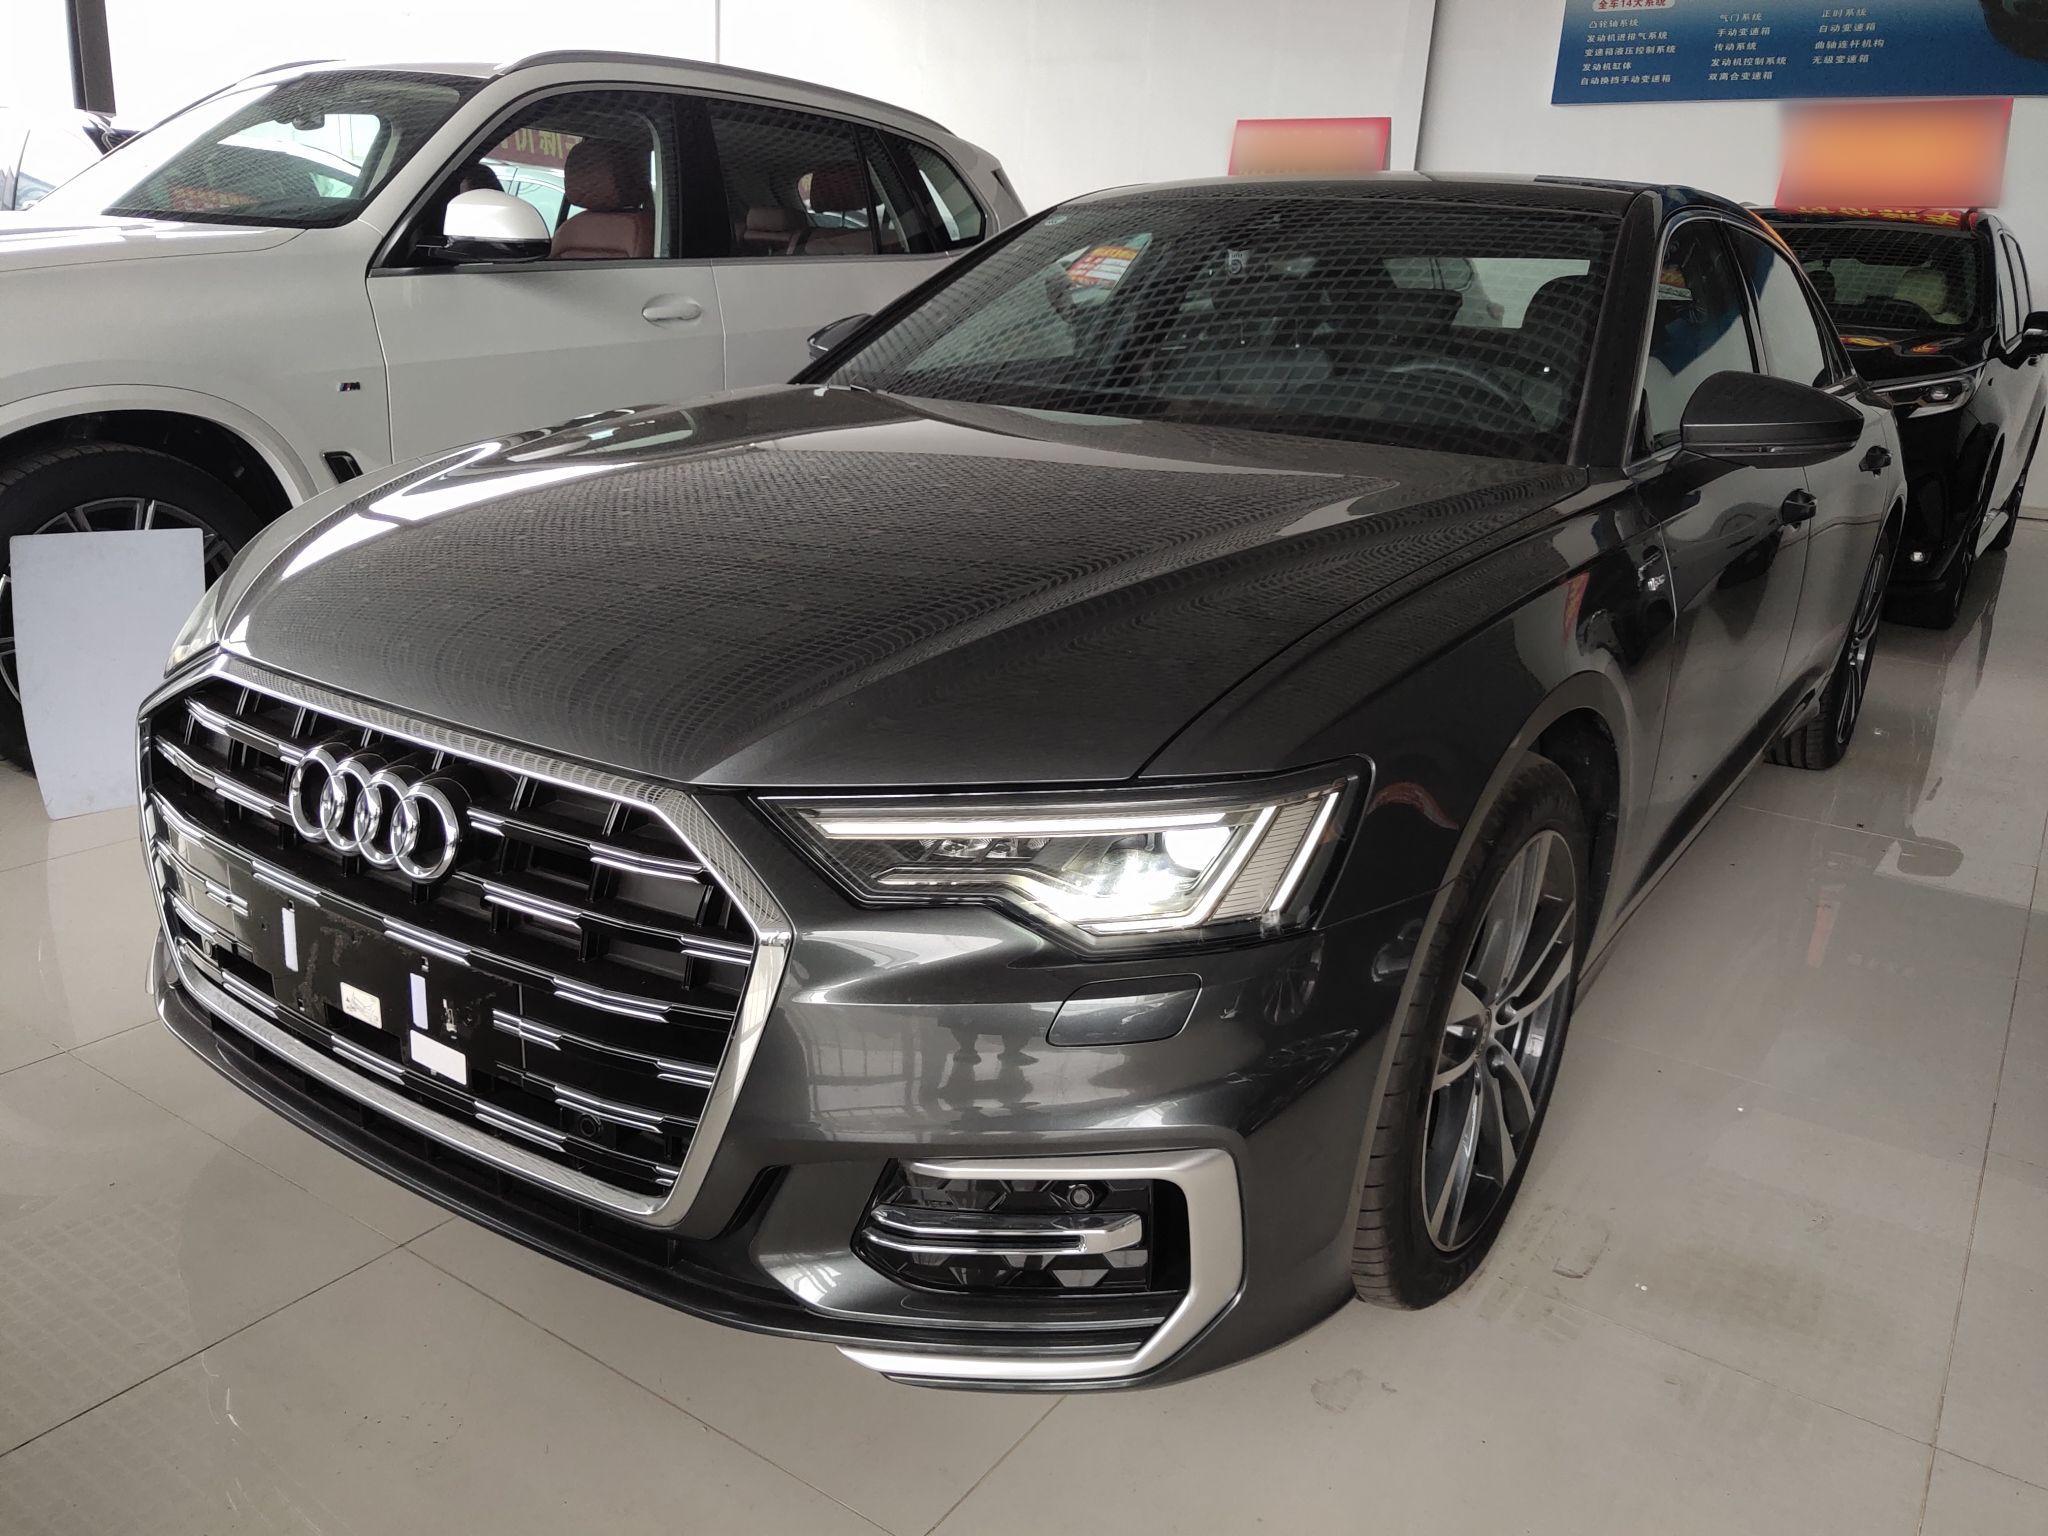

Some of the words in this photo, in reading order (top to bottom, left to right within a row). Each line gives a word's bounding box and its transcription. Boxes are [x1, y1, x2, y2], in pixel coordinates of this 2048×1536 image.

[1720, 12, 1762, 22] 气门系统
[1822, 8, 1868, 18] 正时系统
[1589, 19, 1639, 29] 凸轮轴系统
[1819, 22, 1876, 33] 自动变速箱
[1587, 31, 1669, 43] 发动机进排气系统
[1717, 26, 1771, 37] 手动变速箱
[1714, 42, 1757, 52] 传动系统
[1814, 39, 1884, 50] 曲轴连杆机构
[1585, 45, 1677, 57] 变速箱液压控制系统
[1711, 56, 1787, 67] 发动机控制系统
[1812, 54, 1870, 65] 无级变速箱
[1582, 61, 1632, 72] 发动机缸体
[1708, 71, 1773, 81] 双离合变速箱
